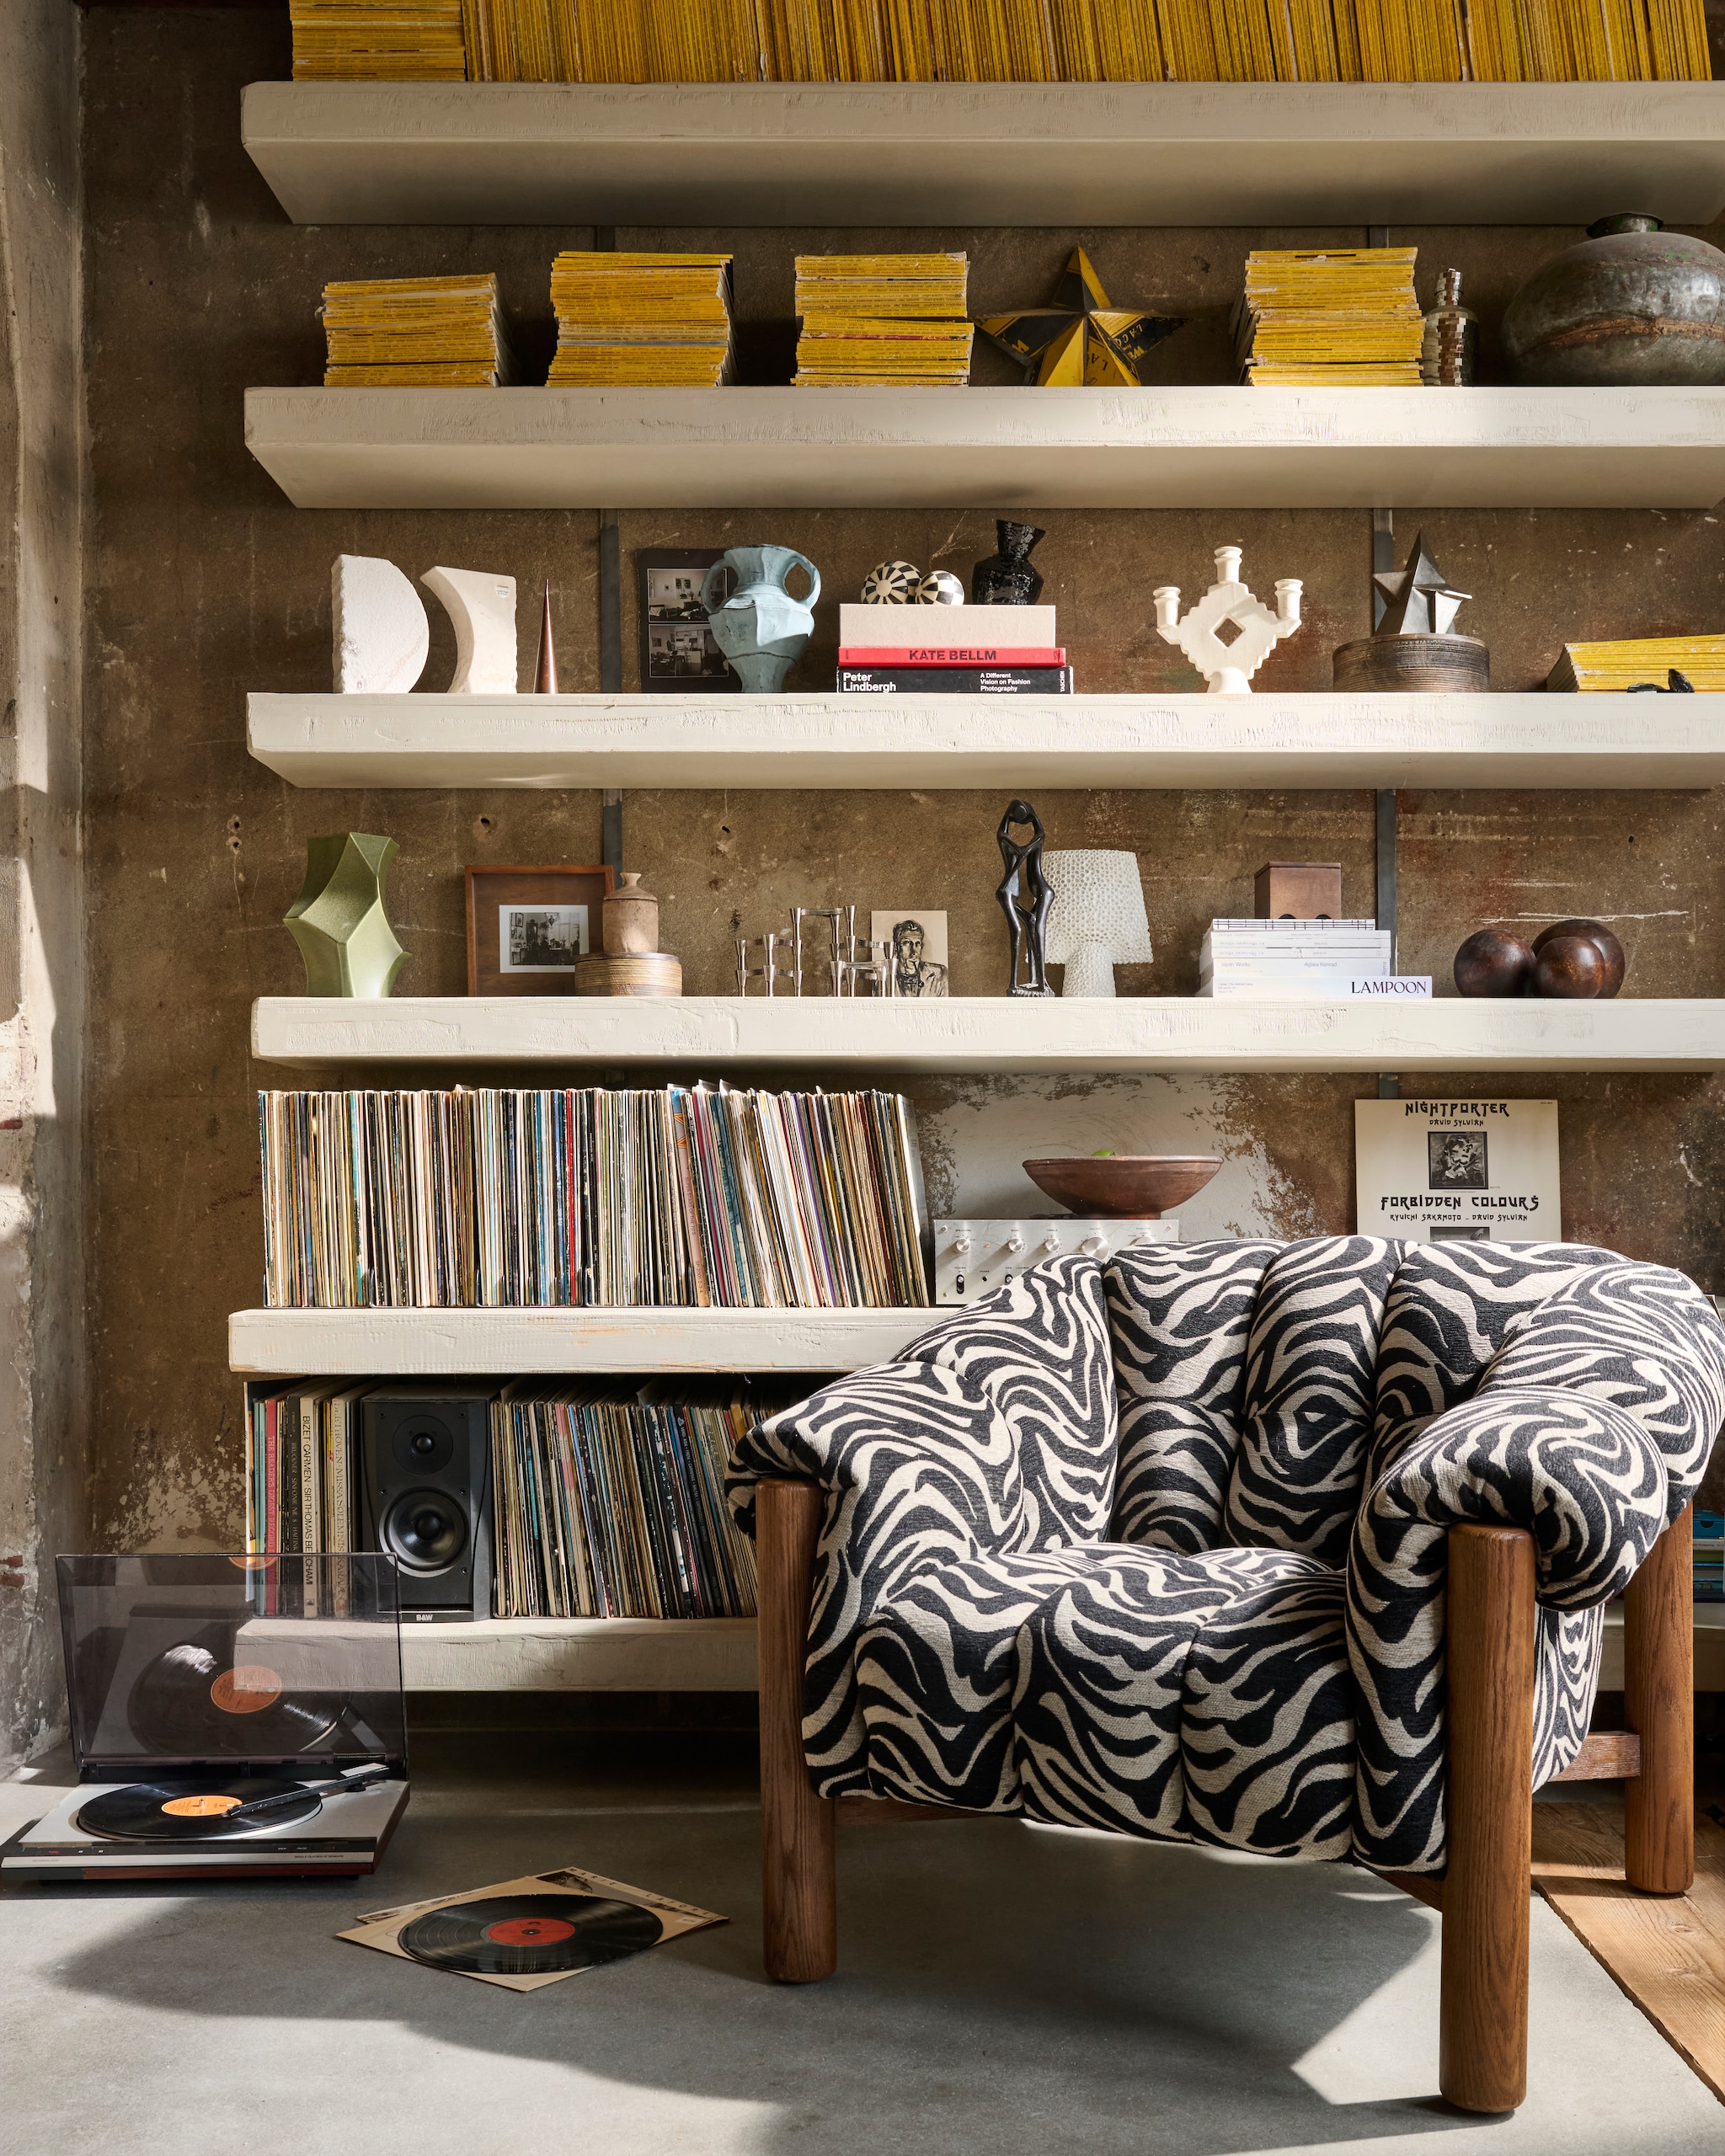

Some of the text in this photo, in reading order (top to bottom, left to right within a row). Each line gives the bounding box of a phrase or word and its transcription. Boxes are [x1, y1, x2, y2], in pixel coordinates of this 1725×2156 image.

[909, 650, 996, 661] KATE BELLM
[843, 672, 873, 681] Peter
[843, 681, 897, 693] Lindbergh
[1351, 981, 1427, 994] LAMPOON
[1405, 1101, 1510, 1118] NIGHTPORTER
[1453, 1118, 1484, 1127] SYLVIAN
[1381, 1194, 1539, 1211] FORBIDDEN COLOURS
[1390, 1214, 1418, 1222] RYUICHI
[1422, 1214, 1461, 1222] SAKAMOTO
[1497, 1214, 1528, 1222] SYLVIAN
[302, 1416, 311, 1441] BIZET
[303, 1444, 312, 1482] CARMEN
[335, 1468, 344, 1499] MISSA
[304, 1502, 312, 1540] THOMAS
[336, 1499, 344, 1552] SOLEMNIS
[305, 1540, 313, 1585] BEECHAM
[569, 1868, 617, 1886] MARIE
